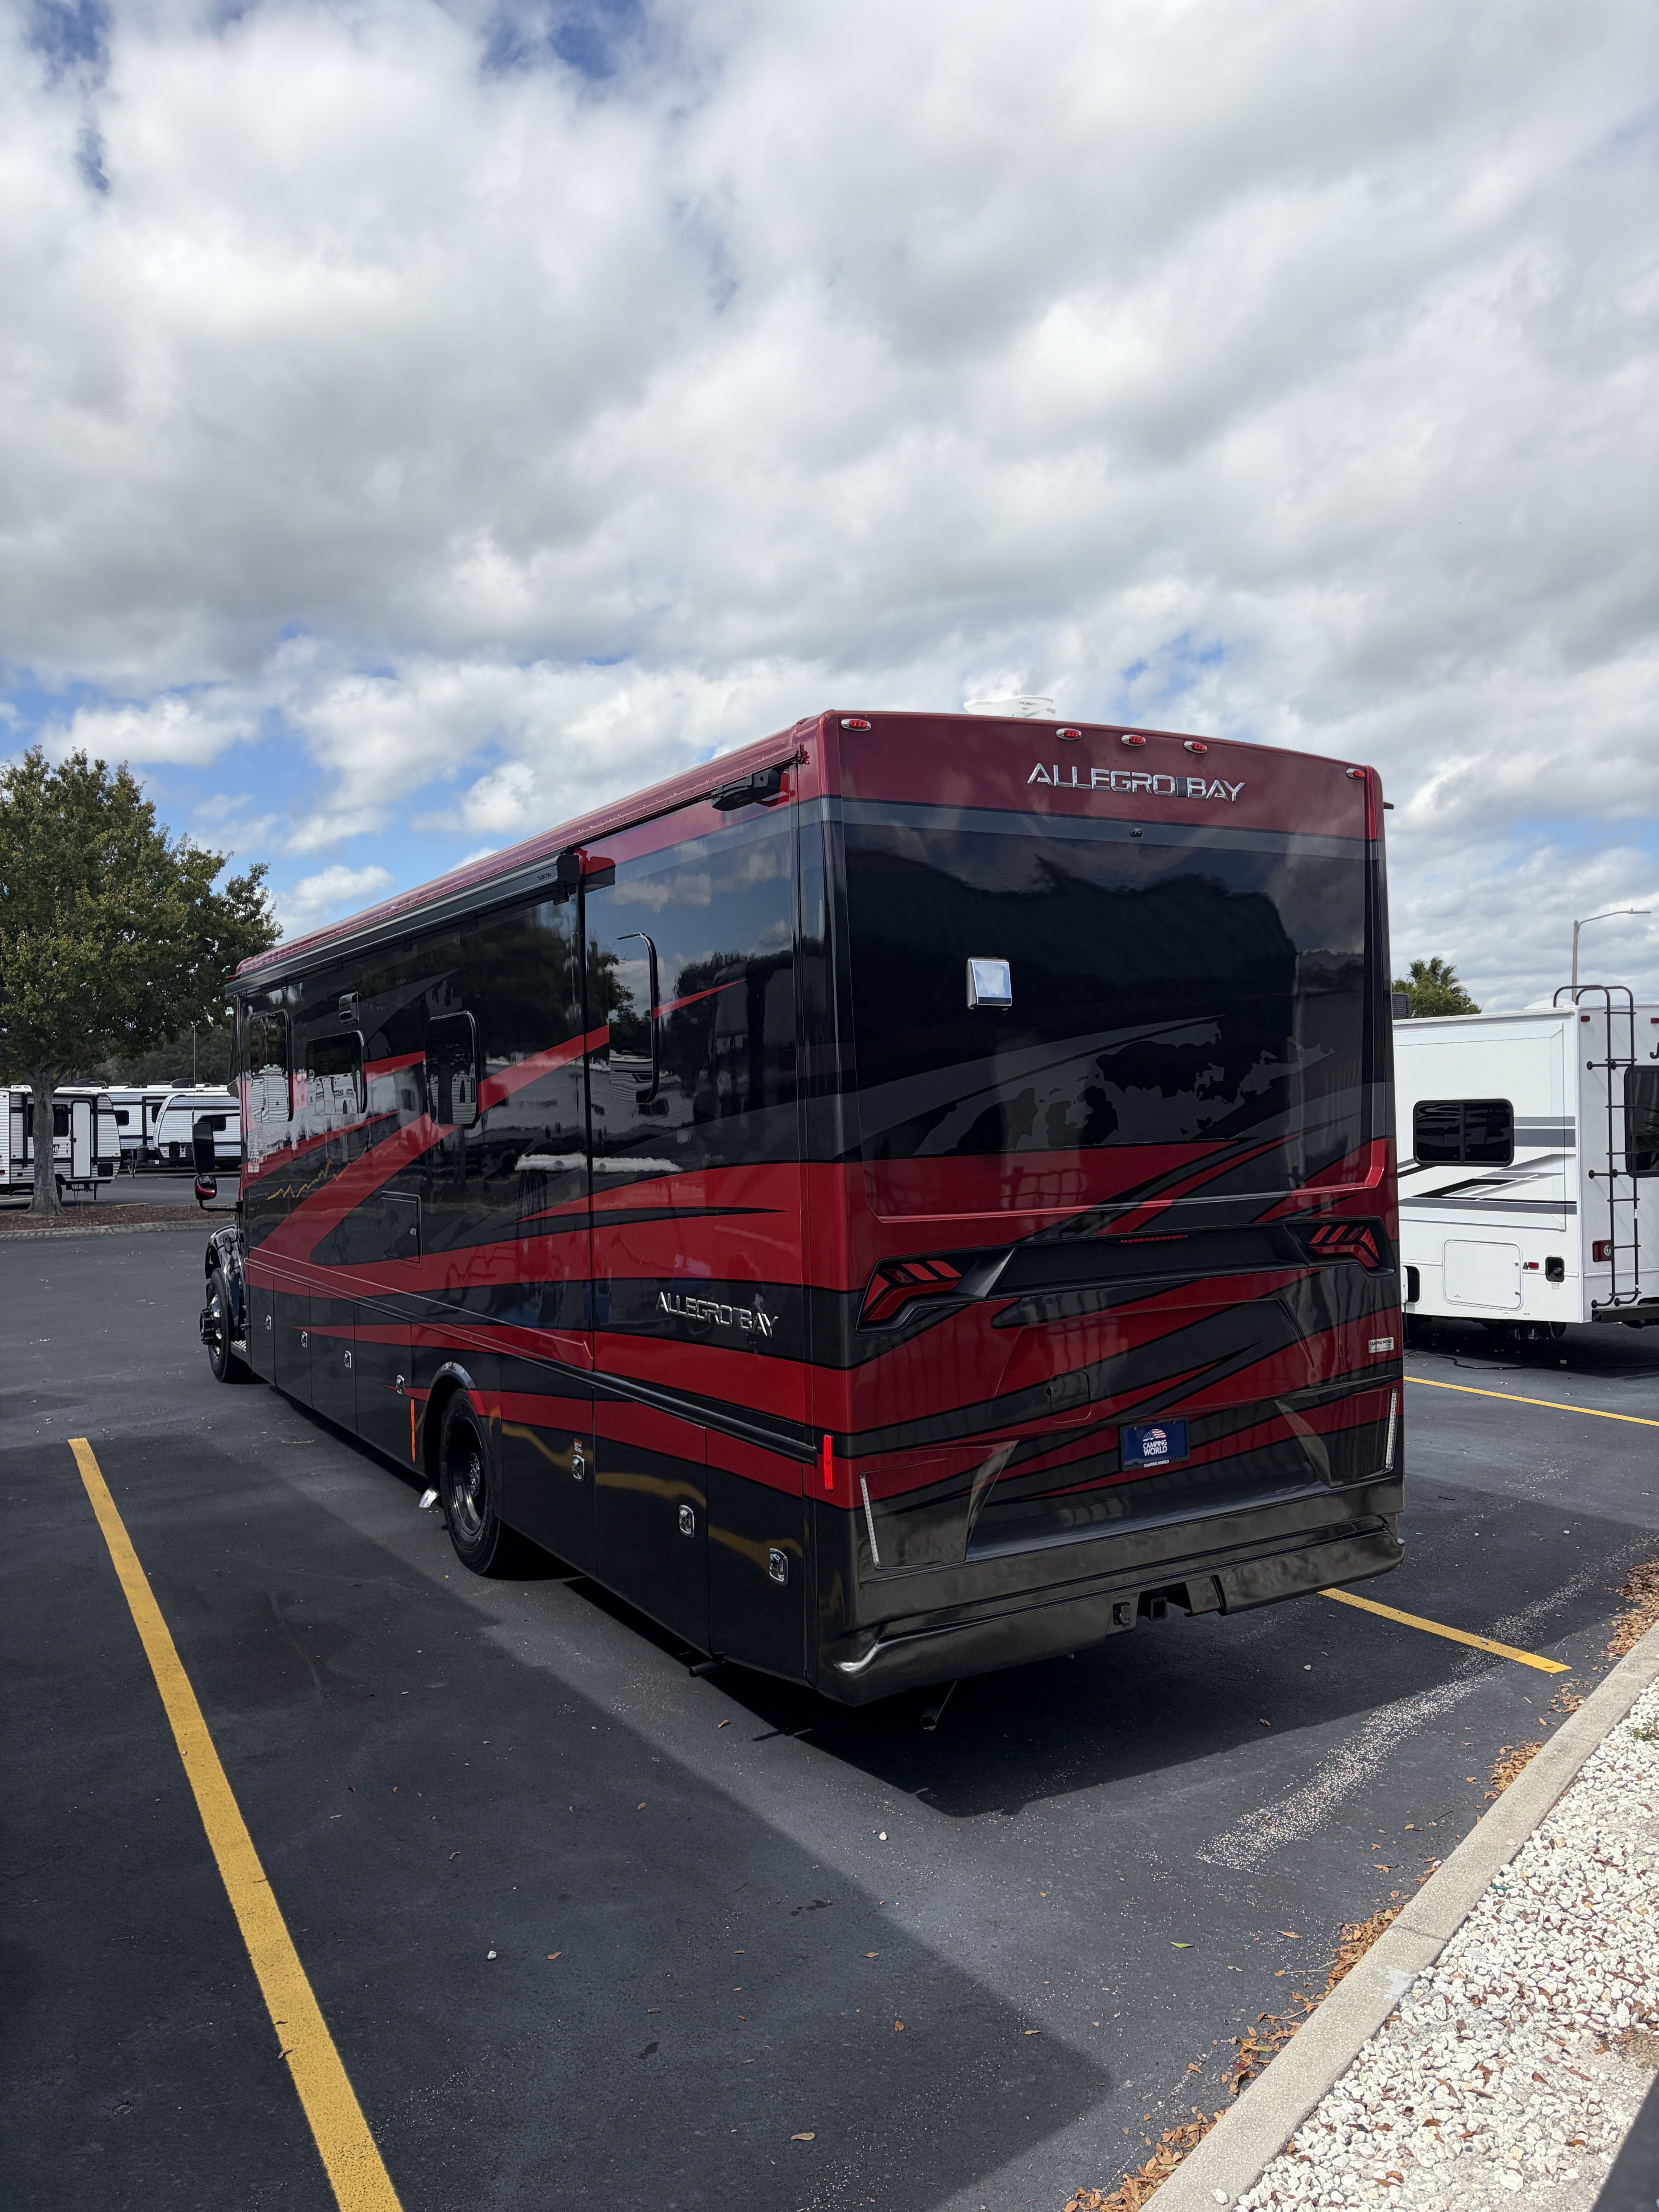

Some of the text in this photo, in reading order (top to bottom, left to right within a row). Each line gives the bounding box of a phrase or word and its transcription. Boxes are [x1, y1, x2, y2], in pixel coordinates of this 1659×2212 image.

[1027, 763, 1246, 802] ALLEGRO BAY
[656, 1291, 779, 1338] ALLEGRO BAY
[1143, 1439, 1167, 1449] CAMPING
[1144, 1446, 1167, 1456] WORLD
